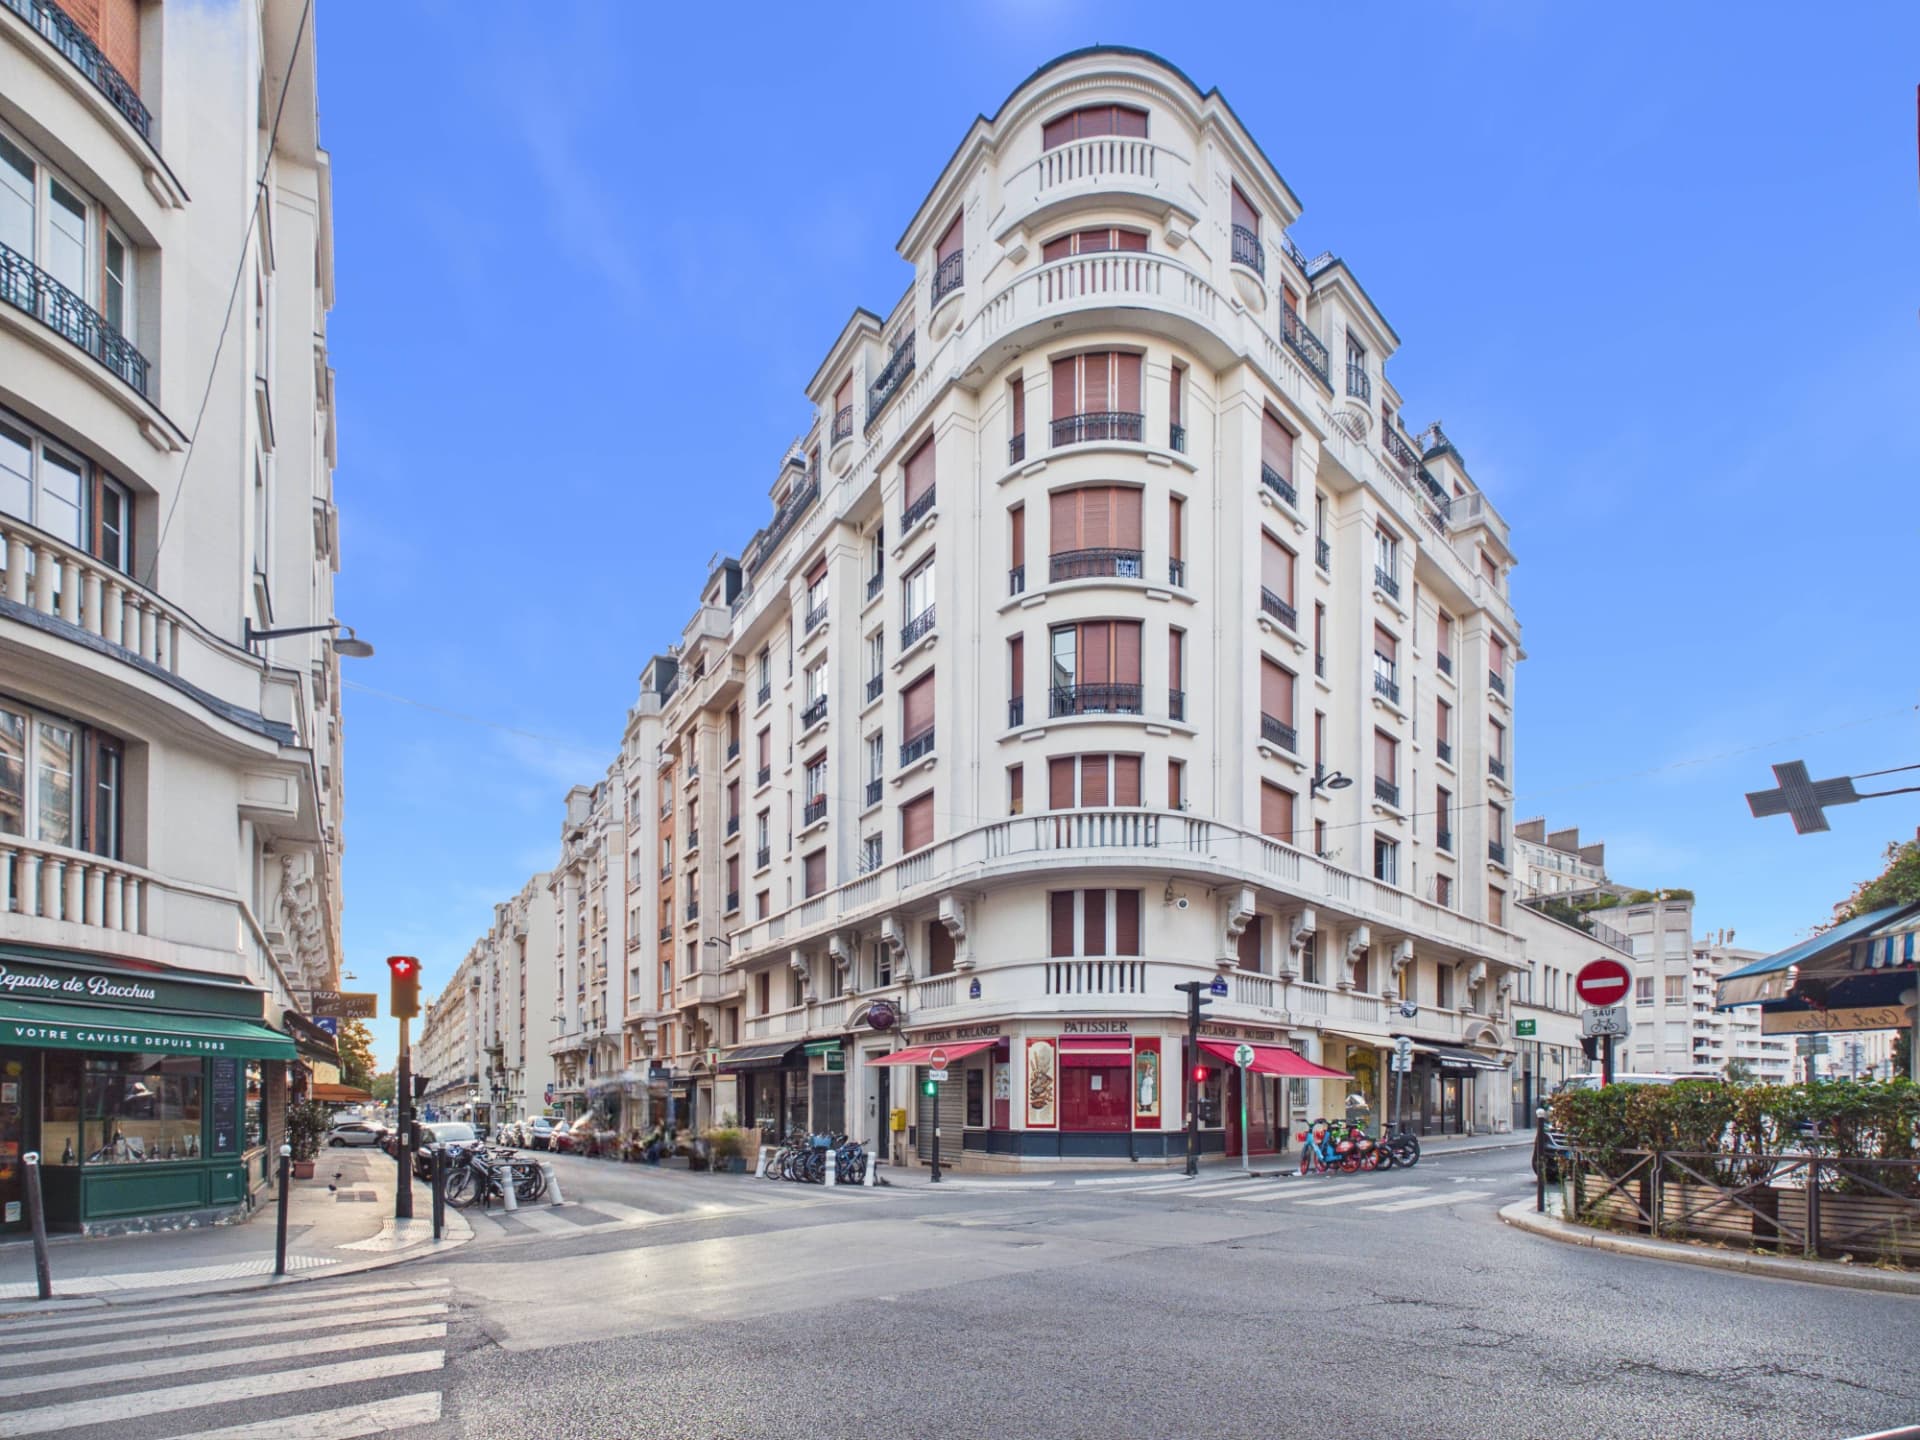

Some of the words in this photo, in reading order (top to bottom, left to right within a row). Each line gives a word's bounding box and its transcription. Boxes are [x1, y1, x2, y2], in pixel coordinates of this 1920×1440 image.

[62, 976, 84, 992] de
[87, 975, 156, 999] Bacchus
[313, 991, 340, 999] PIZZA
[1592, 1008, 1617, 1017] SAUF
[956, 1024, 1000, 1039] BOULANGER
[1064, 1021, 1128, 1033] PATISSIER
[1197, 1024, 1237, 1037] OULANGER
[15, 1027, 68, 1040] VOTRE
[77, 1032, 138, 1045] CAVISTE
[145, 1037, 192, 1048] DEPUIS
[198, 1041, 225, 1050] 1983
